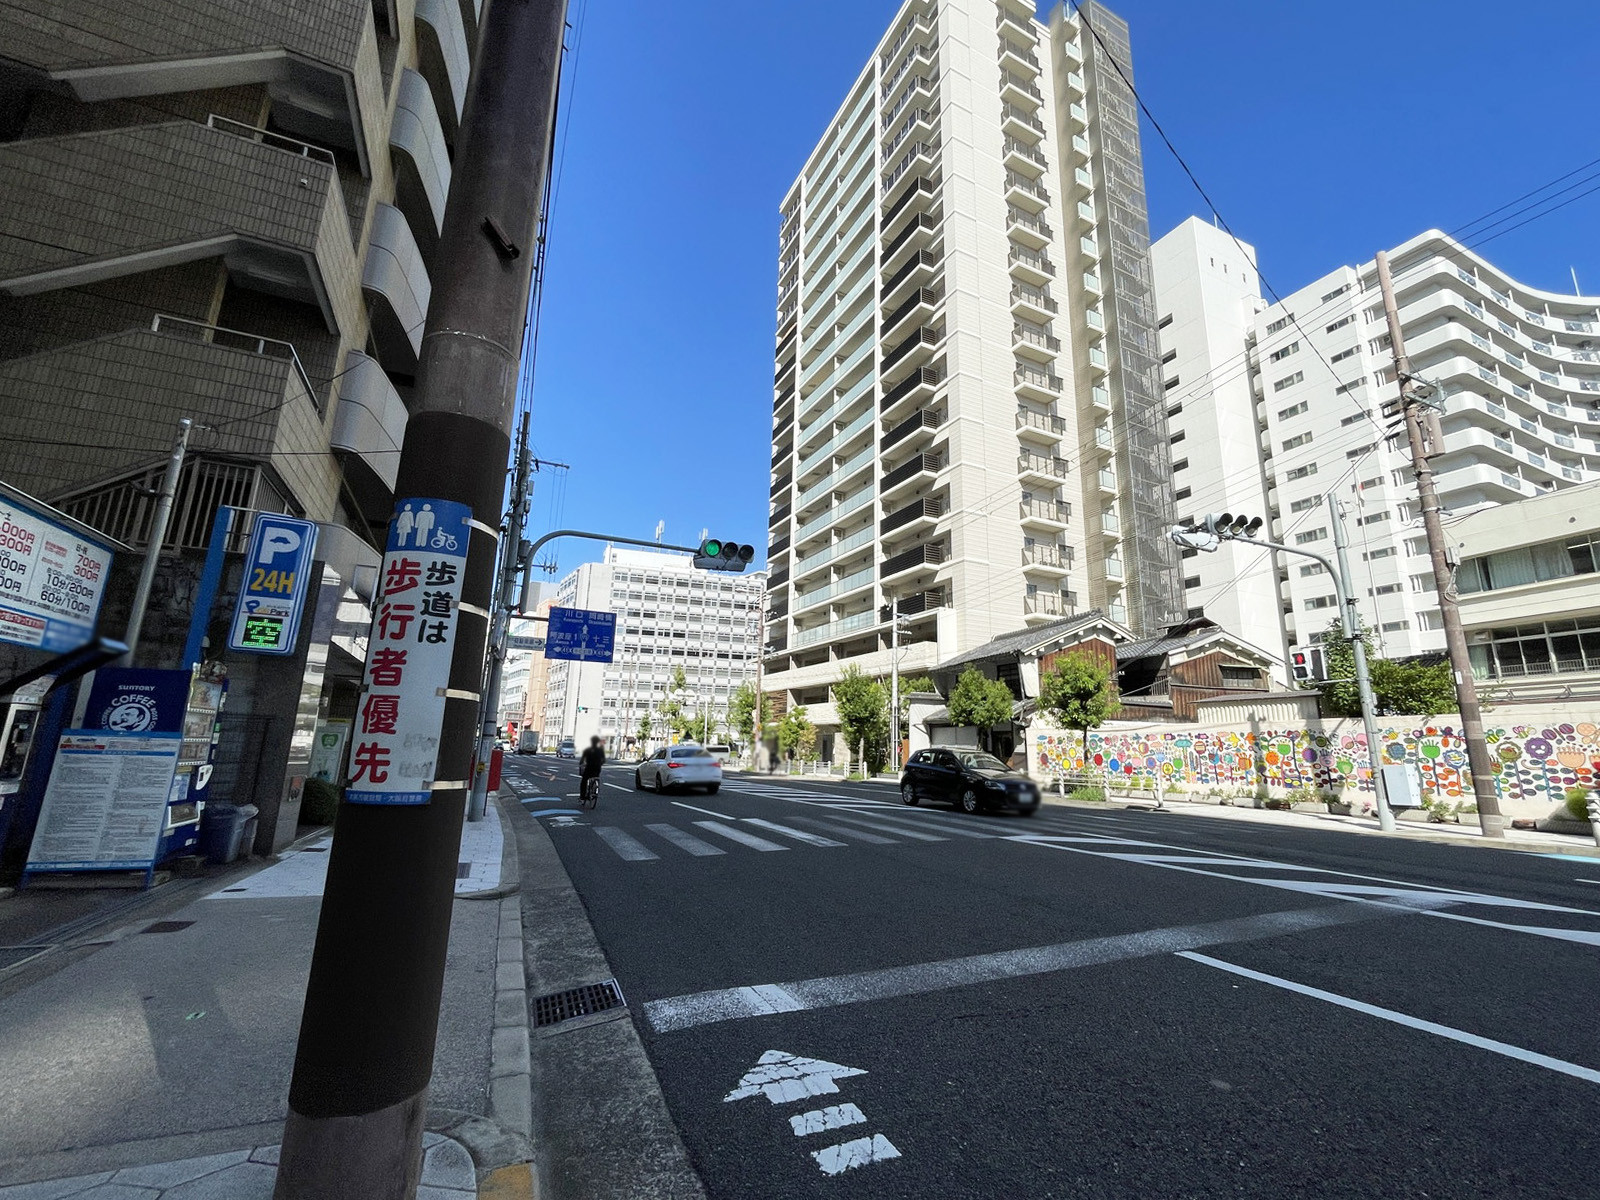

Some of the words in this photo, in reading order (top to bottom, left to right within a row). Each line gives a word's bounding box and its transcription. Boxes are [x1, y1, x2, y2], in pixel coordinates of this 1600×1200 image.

[259, 527, 300, 564] P
[0, 556, 27, 575] 00円
[73, 565, 99, 583] 300円
[77, 554, 102, 573] 700円
[47, 573, 95, 599] 10分/200円
[250, 568, 295, 595] 24H
[40, 590, 91, 614] 60分/100円
[418, 560, 458, 644] 歩道は
[352, 557, 422, 783] 歩行者優先
[111, 694, 157, 708] COFFEE
